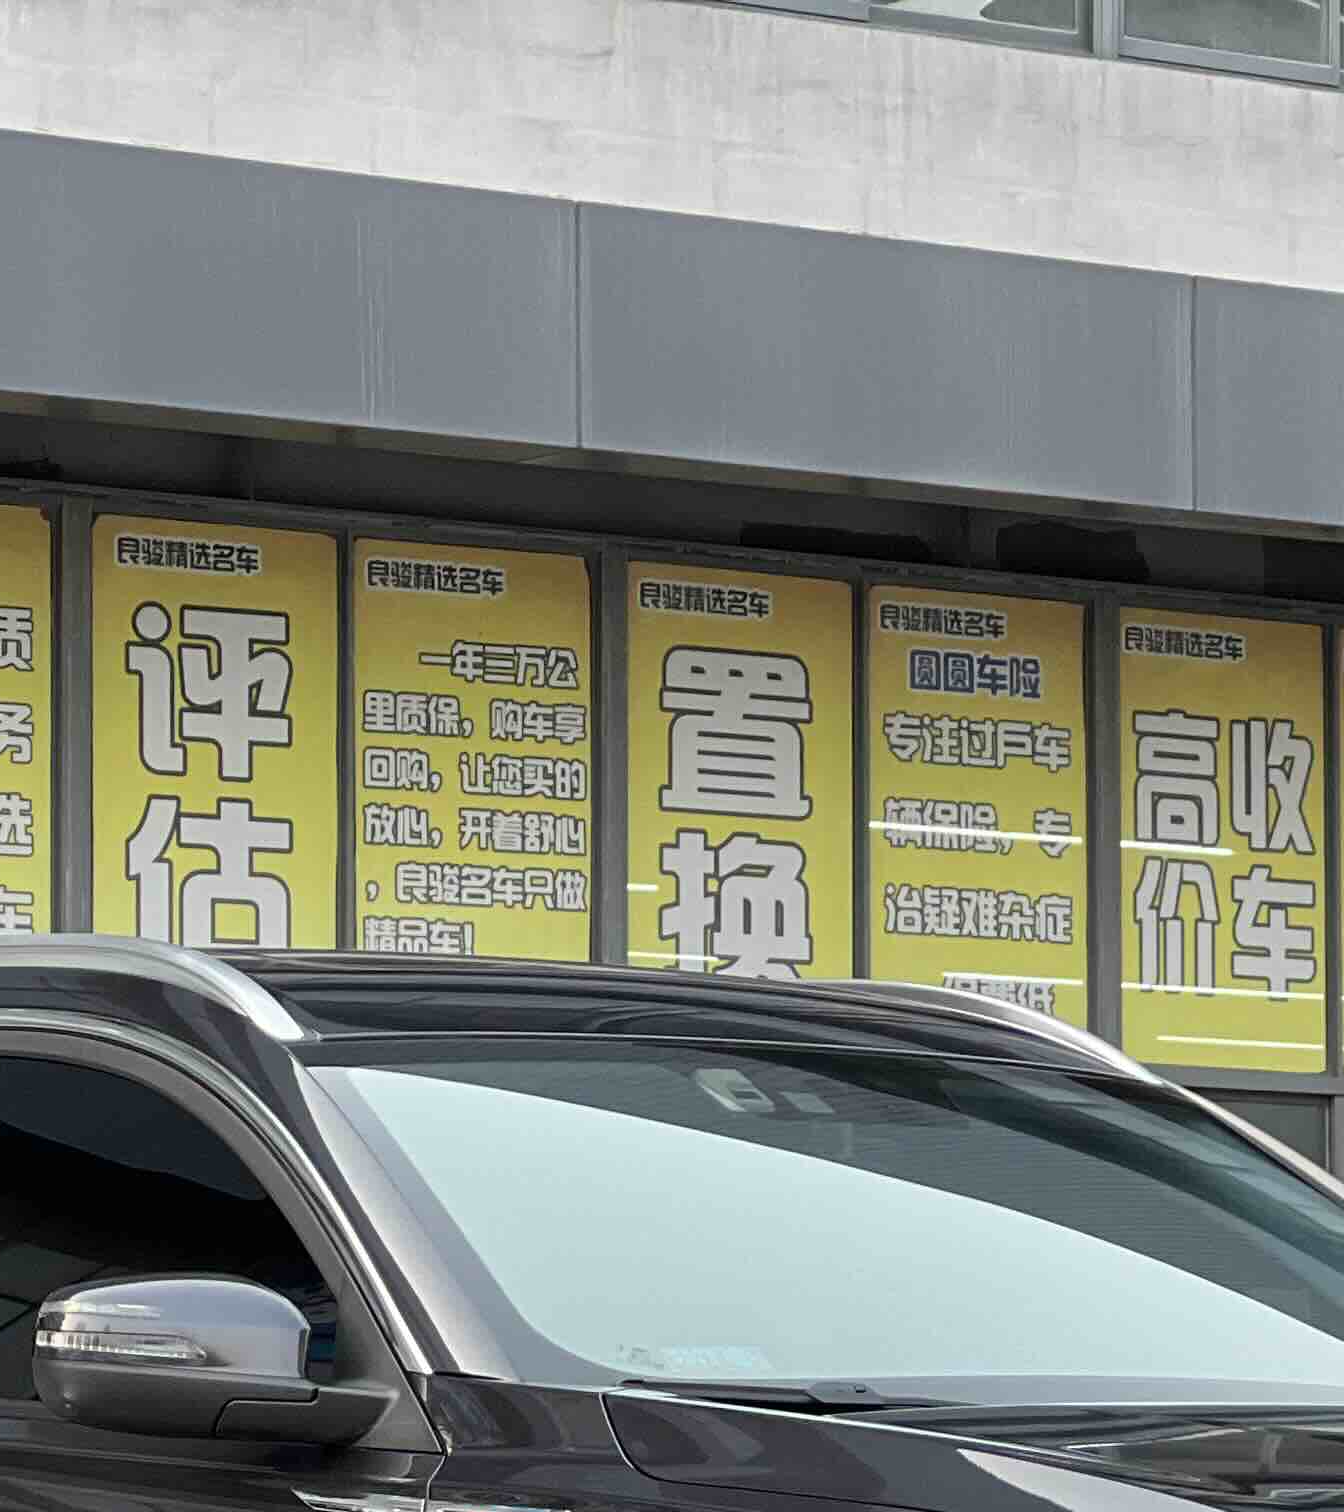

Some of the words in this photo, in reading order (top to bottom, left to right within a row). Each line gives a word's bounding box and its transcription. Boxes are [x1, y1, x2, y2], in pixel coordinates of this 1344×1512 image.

[116, 535, 260, 575] 良骏精选名车
[366, 560, 505, 597] 良骏精选名车
[639, 582, 770, 619] 良骏精选名车
[879, 603, 1006, 640] 良骏精选名车
[418, 639, 579, 690] 一年三万公
[1124, 625, 1244, 661] 良骏精选名车
[909, 649, 1042, 700] 圆圆车险
[883, 711, 1072, 774] 专注过户车
[124, 600, 294, 950] 评估
[659, 645, 813, 981] 置换
[884, 882, 1074, 945] 治疑难杂症
